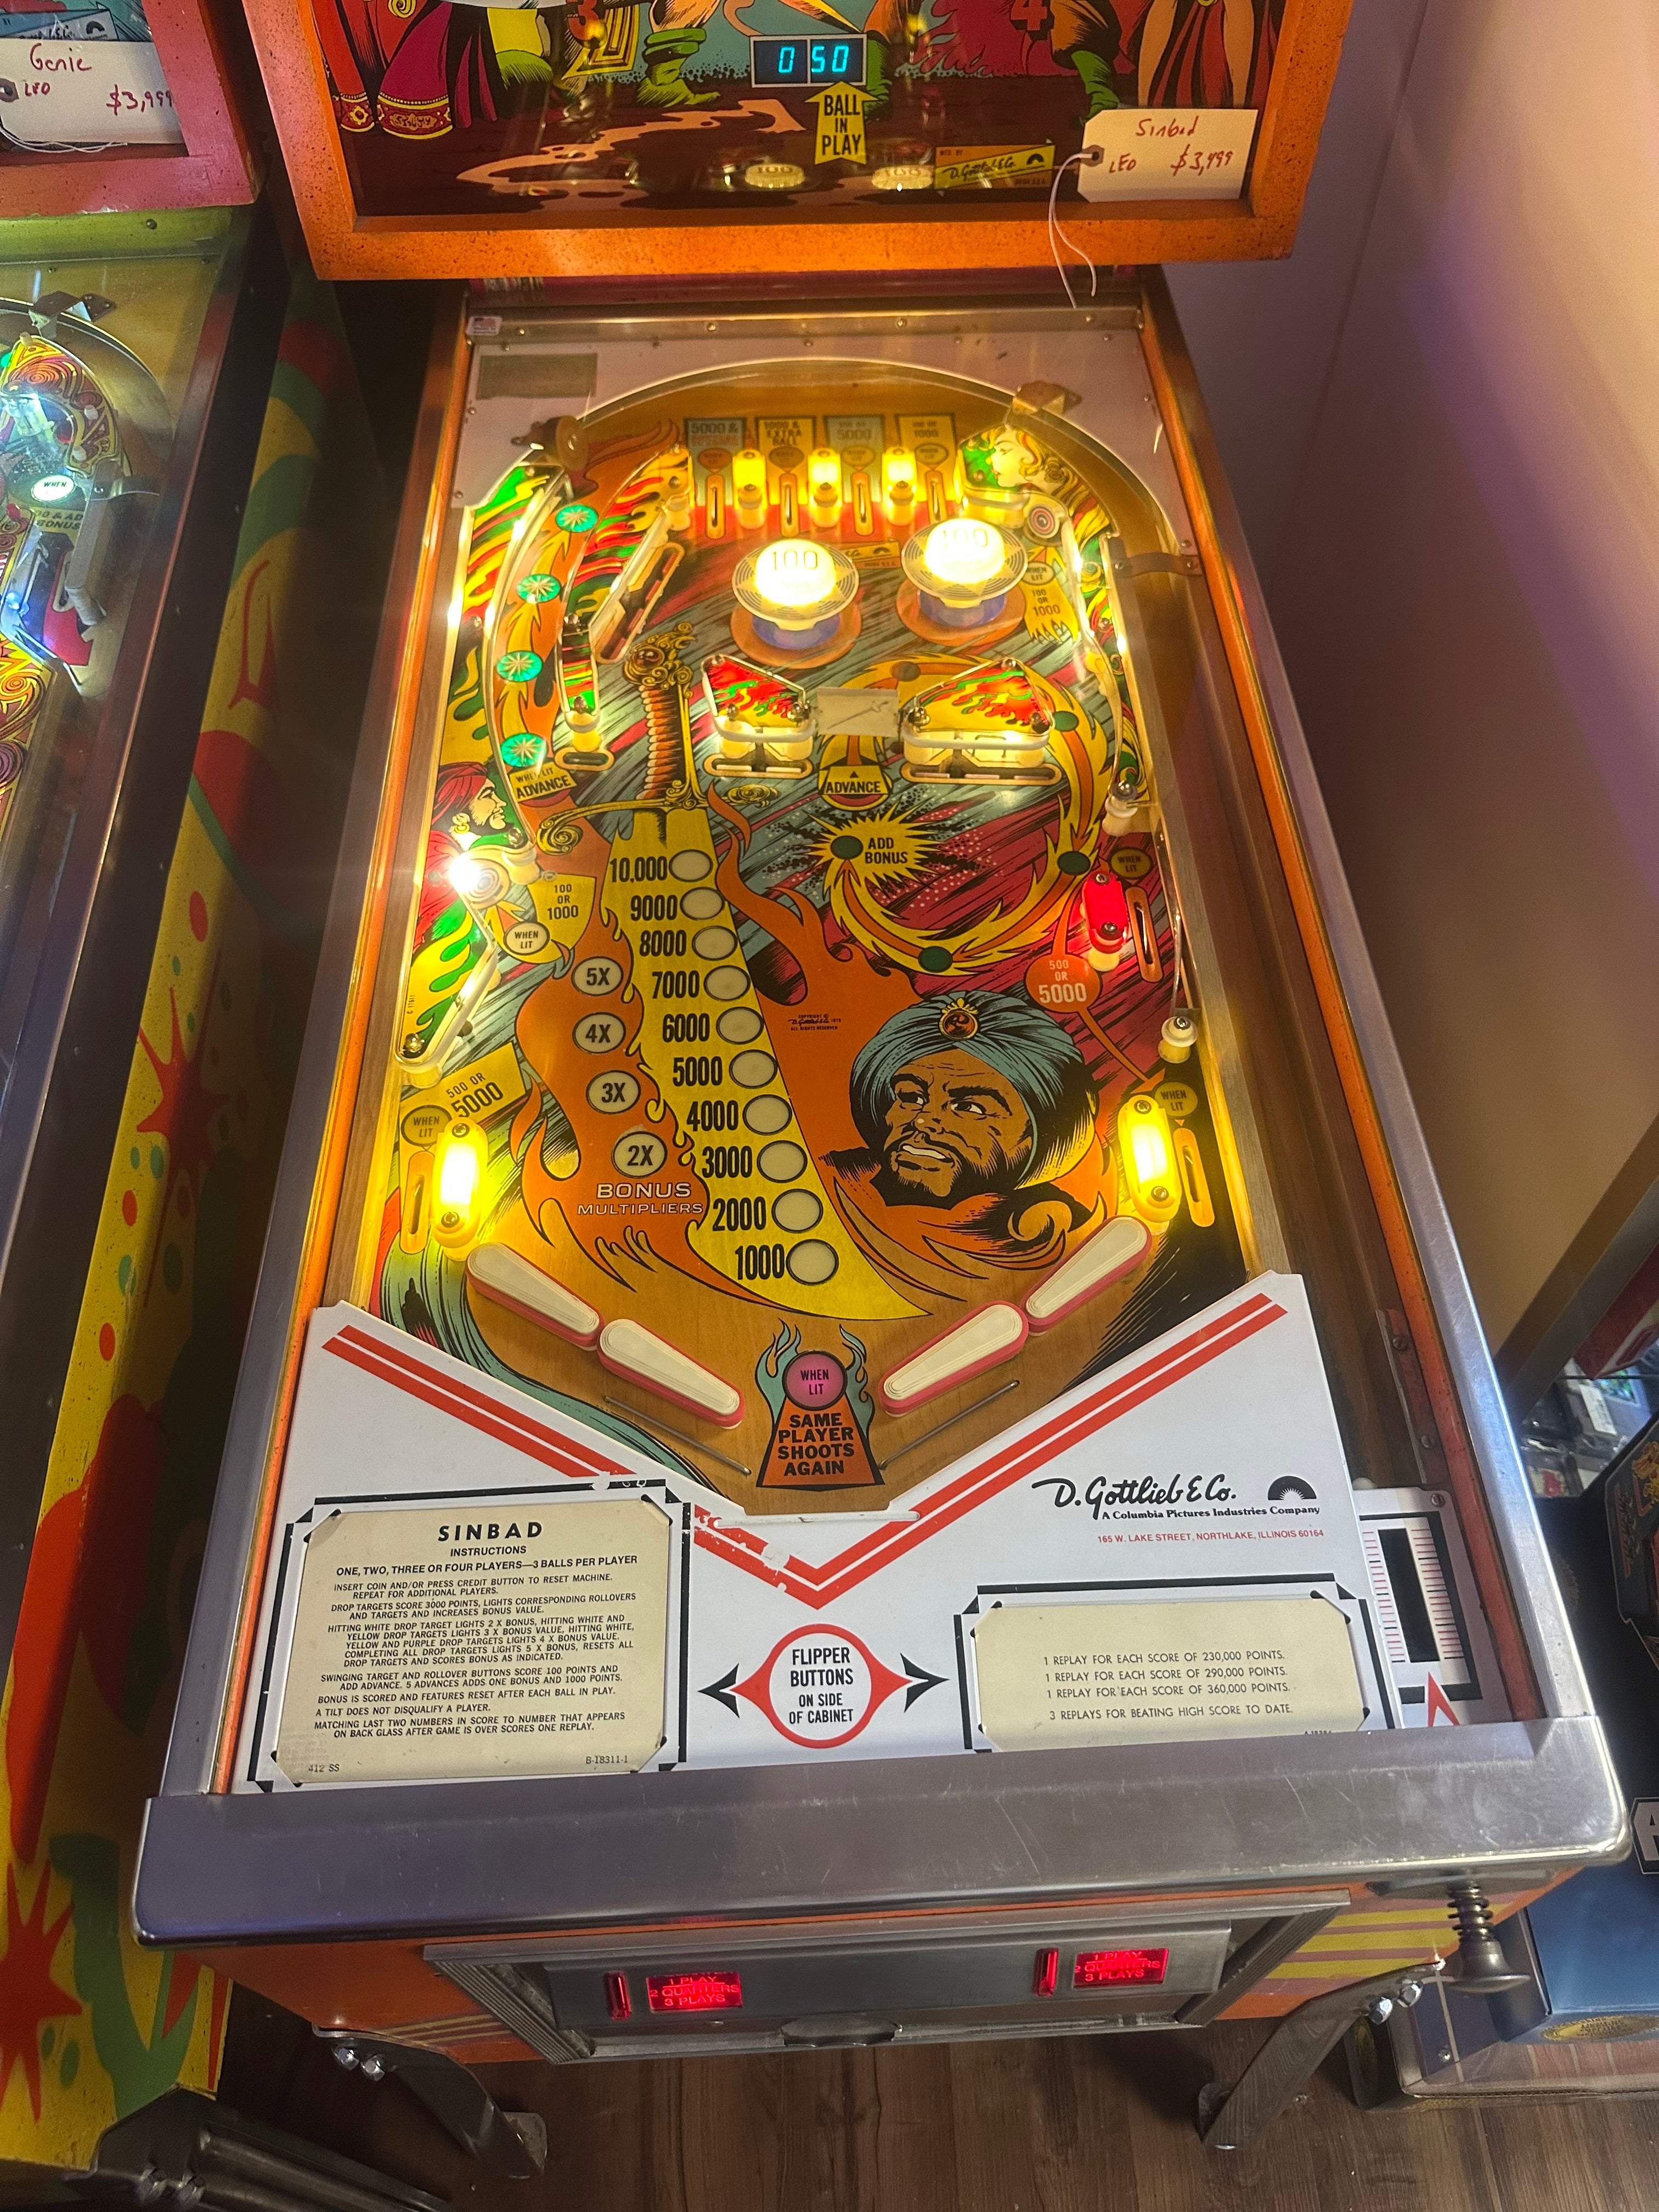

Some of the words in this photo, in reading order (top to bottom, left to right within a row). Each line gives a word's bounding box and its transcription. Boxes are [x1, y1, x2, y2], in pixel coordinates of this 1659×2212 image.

[30, 43, 92, 72] Genie
[778, 47, 795, 74] 0
[811, 46, 849, 73] 50
[106, 84, 173, 116] $3,999
[824, 94, 860, 116] BALL
[835, 118, 848, 133] IN
[1136, 116, 1199, 138] Sinbad
[822, 135, 861, 155] PLAY
[1170, 144, 1234, 177] $3,999
[767, 430, 802, 438] EXTRA
[772, 550, 818, 571] 100
[1032, 589, 1047, 597] 100
[1033, 604, 1061, 617] 1000
[542, 767, 554, 777] LIT
[516, 775, 572, 799] ADVANCE
[826, 781, 881, 793] ADVANCE
[868, 837, 894, 850] ADD
[865, 851, 909, 865] BONUS
[1117, 855, 1141, 864] WHEN
[610, 856, 668, 884] 10,000
[1125, 865, 1137, 873] LIT
[554, 884, 572, 894] 100
[557, 895, 571, 904] OR
[547, 905, 579, 921] 1000
[630, 895, 678, 921] 9000
[515, 930, 539, 939] WHEN
[520, 941, 533, 949] LIT
[639, 930, 687, 957] 8000
[1048, 960, 1069, 970] 500
[586, 967, 610, 986] 5X
[1054, 970, 1068, 981] OR
[652, 970, 700, 999] 7000
[1038, 983, 1087, 1003] 5000
[585, 1024, 611, 1043] 4X
[663, 1013, 710, 1043] 6000
[673, 1056, 723, 1087] 5000
[445, 1081, 468, 1098] 500
[470, 1072, 486, 1085] OR
[601, 1082, 627, 1103] 3X
[450, 1082, 504, 1118] 5000
[1160, 1090, 1187, 1100] WHEN
[1170, 1102, 1183, 1111] LIT
[413, 1116, 440, 1126] WHEN
[686, 1099, 739, 1132] 4000
[419, 1128, 433, 1138] LIT
[627, 1144, 654, 1166] 2X
[702, 1145, 753, 1179] 3000
[596, 1181, 692, 1200] BONUS
[577, 1202, 704, 1216] MULTIPLIERS
[713, 1197, 766, 1232] 2000
[735, 1243, 785, 1280] 1000
[800, 1369, 829, 1381] WHEN
[809, 1384, 823, 1395] LIT
[789, 1412, 843, 1428] SAME
[778, 1427, 854, 1443] PLAYER
[778, 1443, 854, 1460] SHOOTS
[784, 1460, 844, 1476] AGAIN
[1031, 1477, 1081, 1508] D.
[1085, 1474, 1183, 1520] Gottlieb
[1206, 1474, 1237, 1502] Co.
[1102, 1511, 1109, 1520] A
[1112, 1509, 1164, 1520] Columbia
[1166, 1508, 1210, 1517] Pictures
[1213, 1507, 1267, 1517] Industries
[1269, 1505, 1320, 1516] Company
[438, 1521, 542, 1542] SINBAD
[1098, 1534, 1113, 1543] 165
[1115, 1534, 1126, 1542] W.
[1128, 1533, 1153, 1542] LAKE
[1155, 1532, 1194, 1542] STREET,
[1197, 1531, 1256, 1541] NORTHLAKE,
[1258, 1530, 1296, 1539] ILLINOIS
[450, 1545, 527, 1557] INSTRUCTIONS
[336, 1567, 361, 1576] ONE,
[363, 1566, 389, 1576] TWO,
[392, 1565, 426, 1574] THREE
[427, 1564, 442, 1572] OR
[445, 1563, 473, 1572] FOUR
[541, 1559, 573, 1567] BALLS
[575, 1558, 595, 1566] PER
[599, 1555, 637, 1565] PLAYER
[353, 1591, 385, 1599] REPEAT
[407, 1589, 456, 1597] ADDITIONAL
[460, 1587, 499, 1595] PLAYERS.
[792, 1647, 850, 1666] FLIPPER
[1043, 1657, 1048, 1666] 1
[1053, 1656, 1087, 1665] REPLAY
[1093, 1655, 1113, 1664] FOR
[1116, 1654, 1143, 1663] EACH
[1148, 1653, 1179, 1663] SCORE
[1184, 1652, 1198, 1662] OF
[1202, 1651, 1241, 1662] 230,000
[1246, 1650, 1285, 1660] POINTS.
[790, 1668, 854, 1687] BUTTONS
[799, 1694, 814, 1707] ON
[817, 1692, 843, 1706] SIDE
[325, 1708, 343, 1716] TILT
[346, 1707, 369, 1716] DOES
[373, 1706, 391, 1714] NOT
[394, 1705, 443, 1714] DISQUALIFY
[456, 1703, 491, 1712] PLAYER.
[789, 1711, 803, 1724] OF
[808, 1708, 854, 1723] CABINET
[1049, 1711, 1056, 1720] 3
[1060, 1709, 1102, 1719] REPLAYS
[1107, 1709, 1126, 1718] FOR
[1131, 1707, 1173, 1718] BEATING
[1178, 1706, 1204, 1717] HIGH
[1209, 1706, 1241, 1716] SCORE
[1246, 1705, 1260, 1714] TO
[1265, 1704, 1293, 1714] DATE.
[329, 1763, 340, 1772] SS
[1105, 1951, 1142, 1960] PLAY
[1075, 1965, 1081, 1973] 2
[1084, 1960, 1161, 1972] QUARTERS
[1098, 1969, 1145, 1980] PLAYS
[662, 1984, 740, 1997] QUARTERS
[664, 1998, 674, 2006] 3
[679, 1994, 726, 2006] PLAYS
